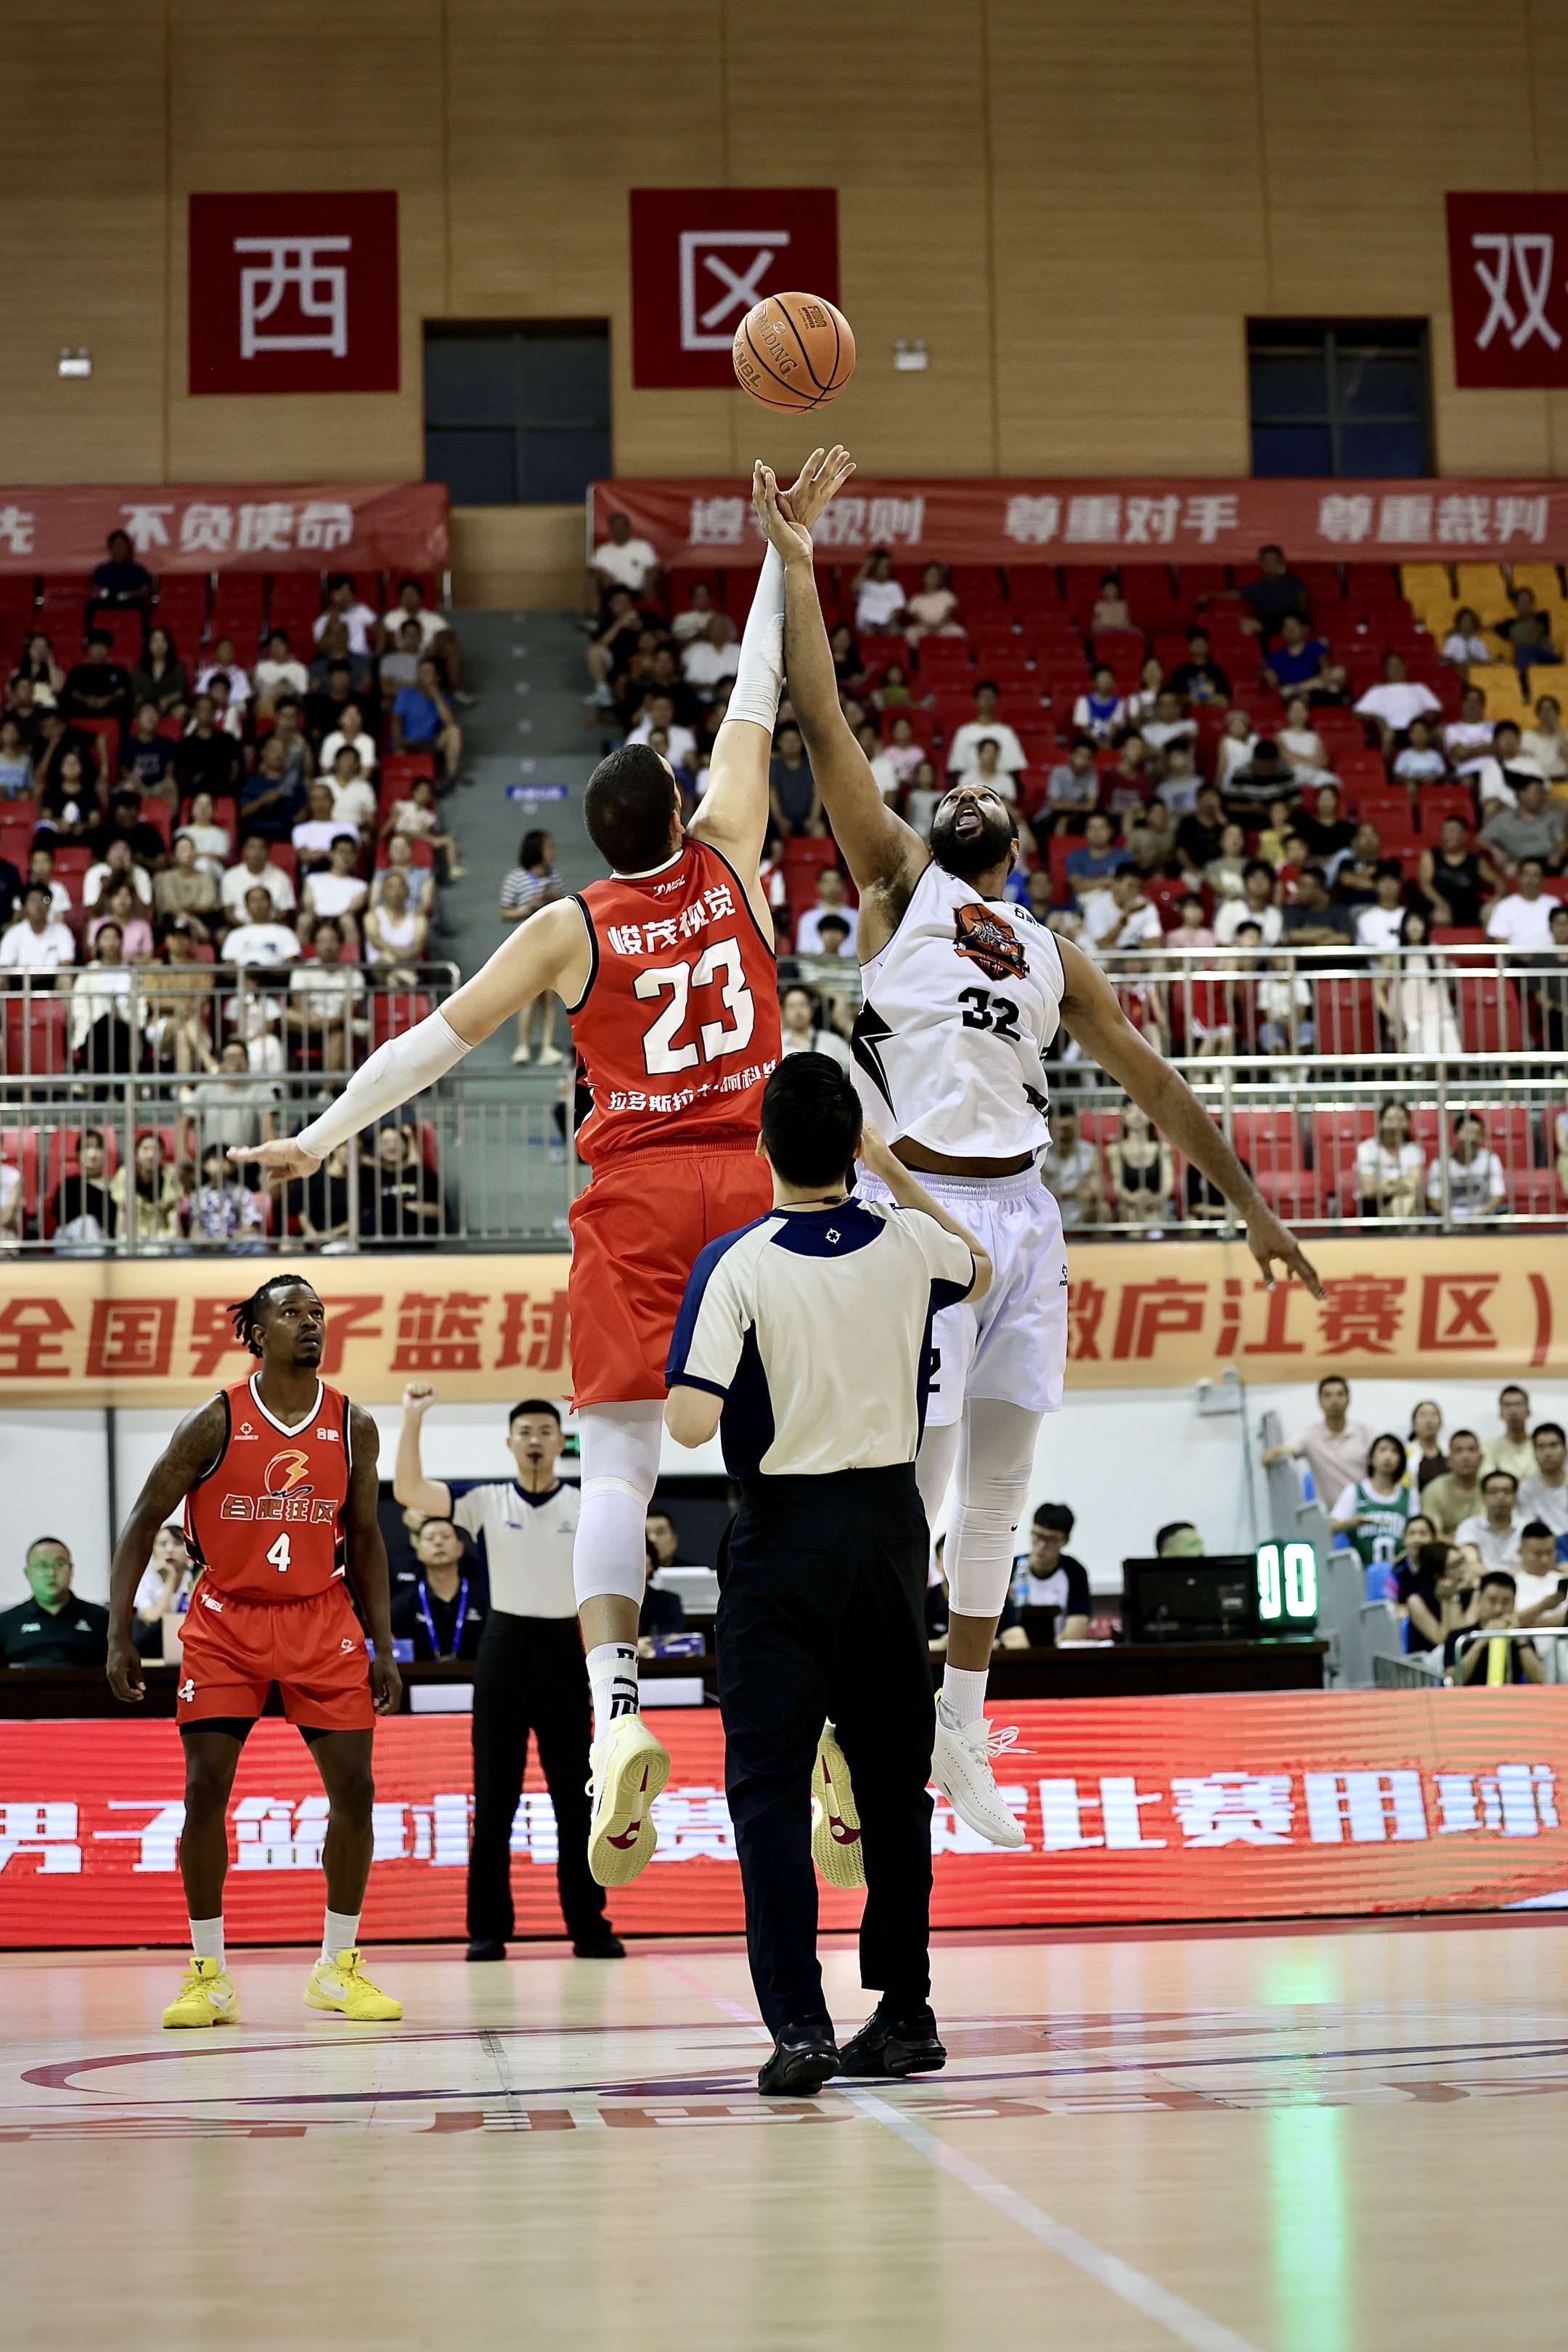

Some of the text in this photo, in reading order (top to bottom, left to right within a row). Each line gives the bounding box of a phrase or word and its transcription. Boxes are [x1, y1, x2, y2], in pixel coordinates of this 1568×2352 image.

[233, 230, 791, 360] 西 区
[1471, 232, 1562, 351] 双
[735, 351, 760, 388] NBL
[120, 502, 354, 554] 不负使命
[687, 494, 1550, 546] 遵规则 尊重对手 尊重裁判
[607, 883, 736, 956] 峻茂视觉
[632, 936, 756, 1076] 23
[957, 987, 1021, 1042] 32
[0, 1289, 570, 1377] 全国男子篮球
[220, 1493, 339, 1526] 合肥狂风
[266, 1531, 291, 1572] 4
[177, 1678, 195, 1703] 4
